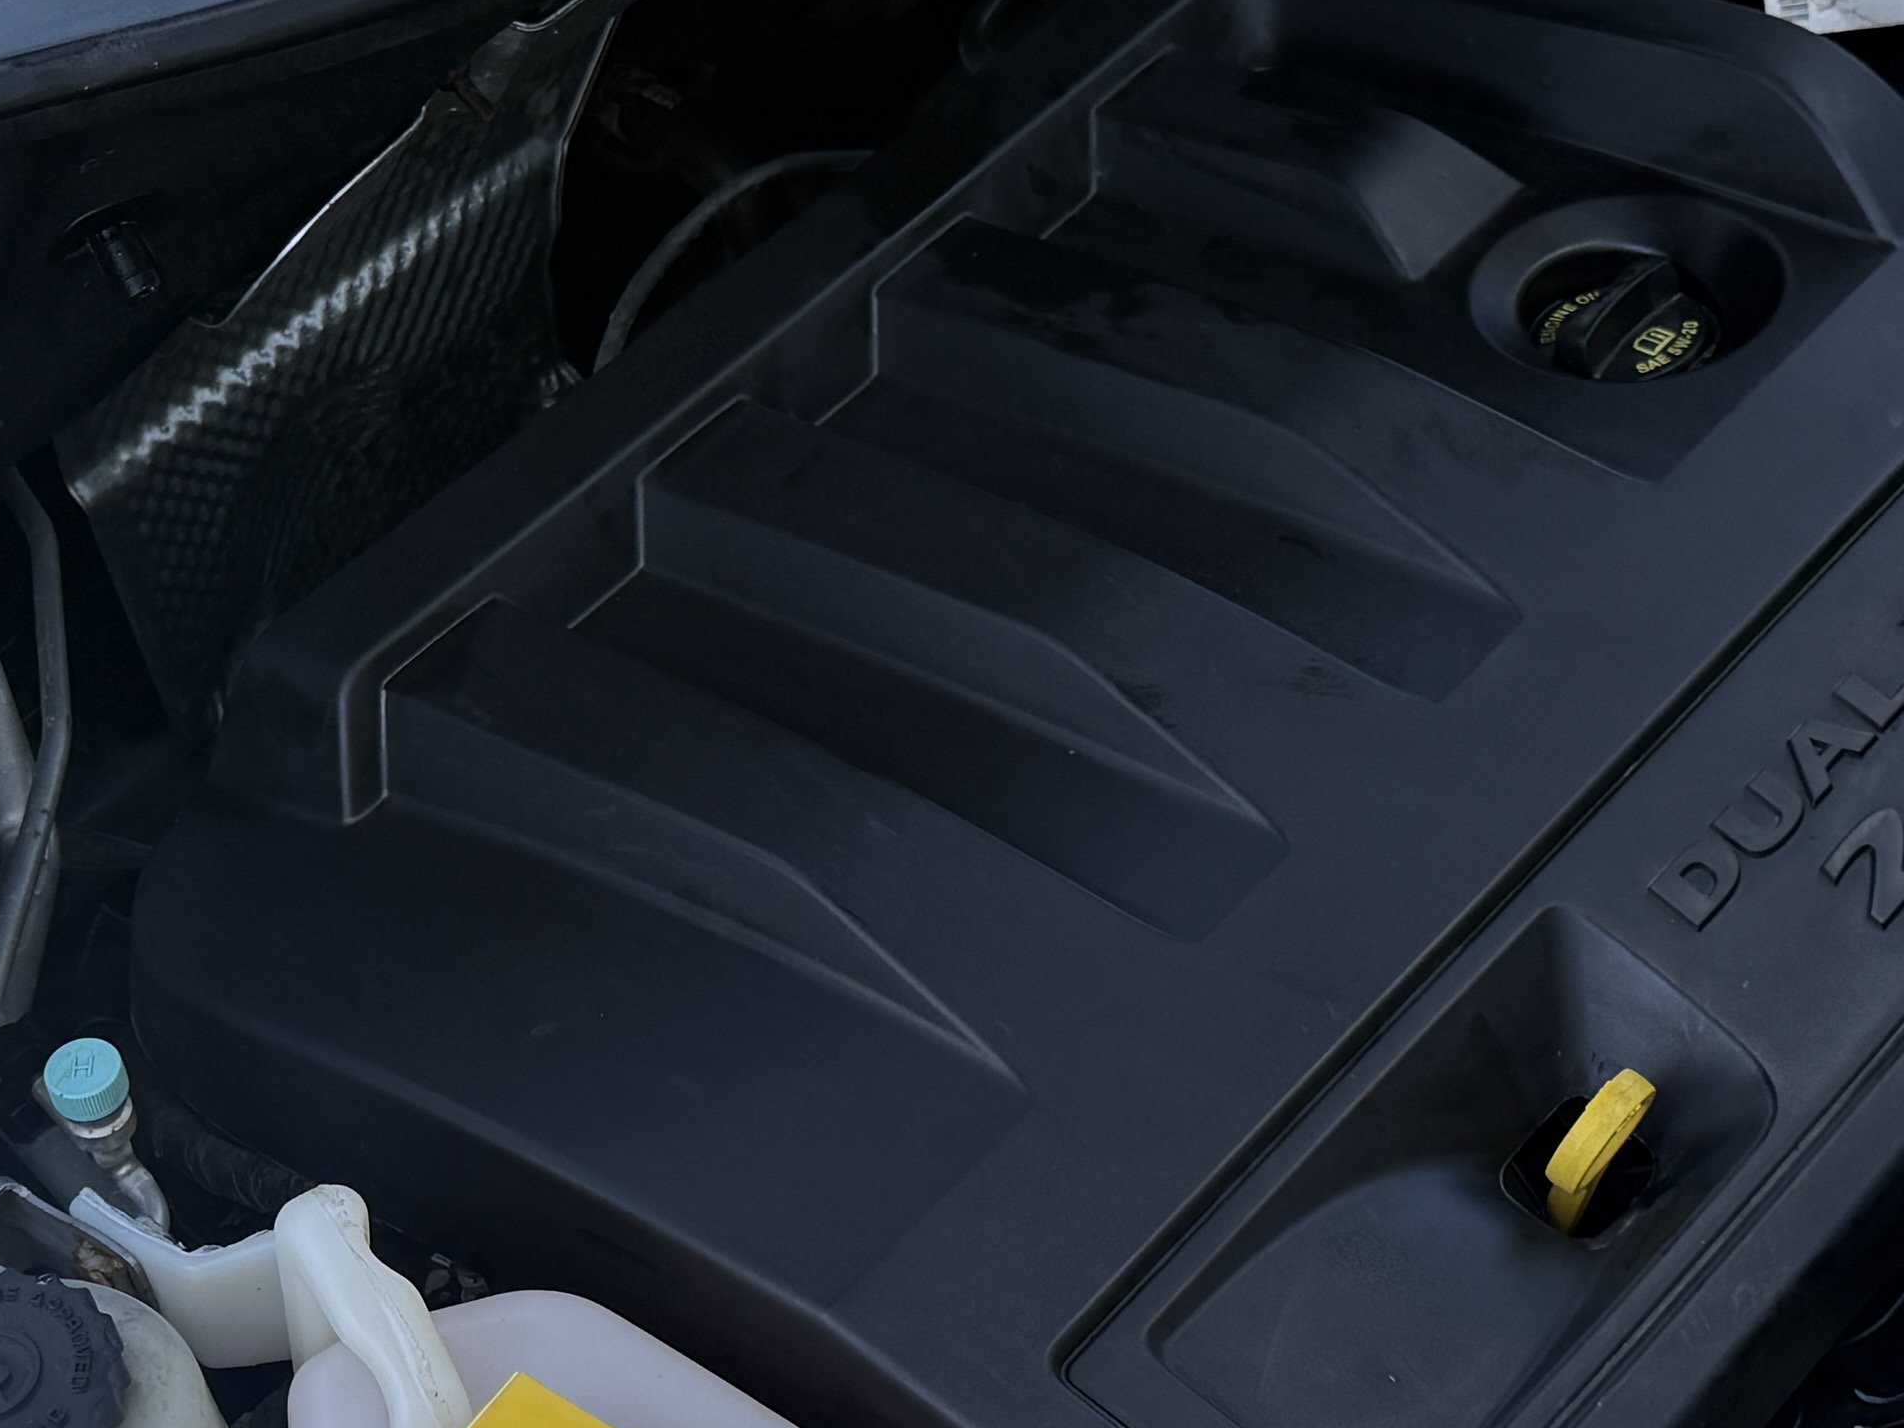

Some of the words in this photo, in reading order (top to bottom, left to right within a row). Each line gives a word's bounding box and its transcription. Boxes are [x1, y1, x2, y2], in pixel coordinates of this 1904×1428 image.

[1539, 302, 1579, 345] ENGINE
[1635, 354, 1672, 374] SAE
[1666, 320, 1700, 357] 5W-20
[70, 1053, 95, 1080] H
